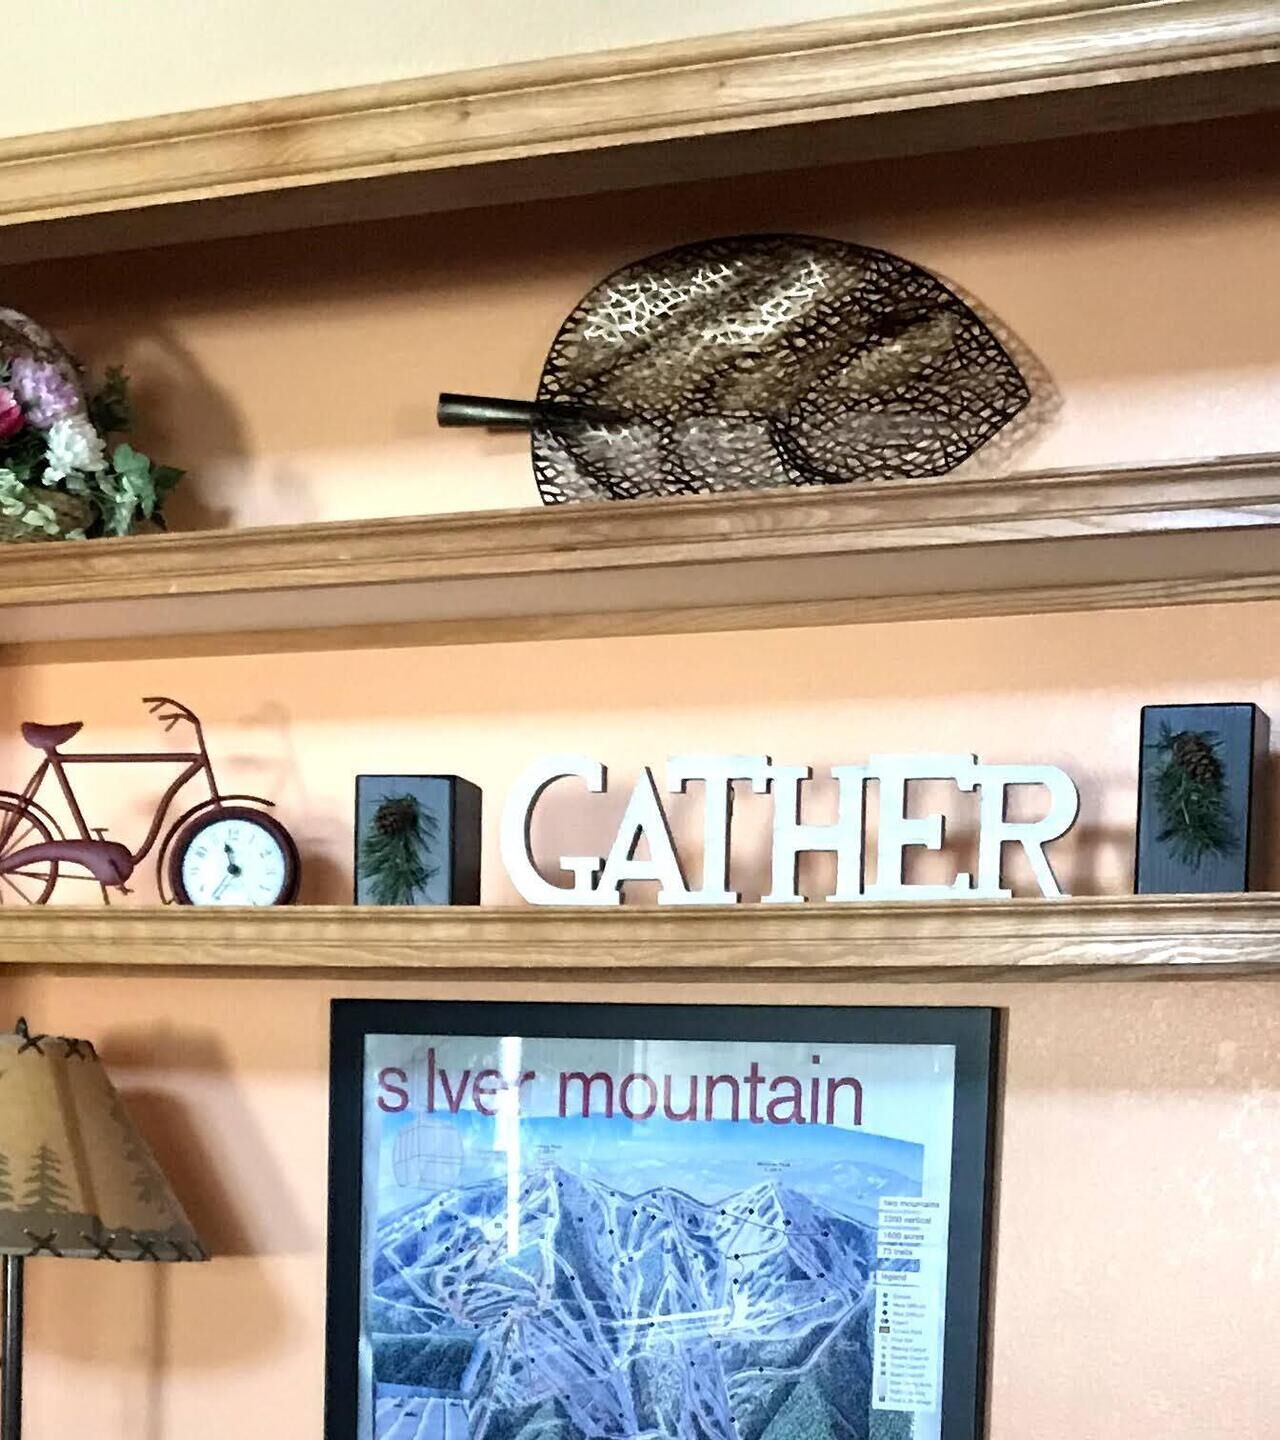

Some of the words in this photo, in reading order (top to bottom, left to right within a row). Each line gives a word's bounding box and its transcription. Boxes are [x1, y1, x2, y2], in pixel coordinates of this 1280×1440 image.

[500, 753, 1080, 906] GATHER
[377, 1047, 536, 1117] slver
[559, 1054, 863, 1126] mountain
